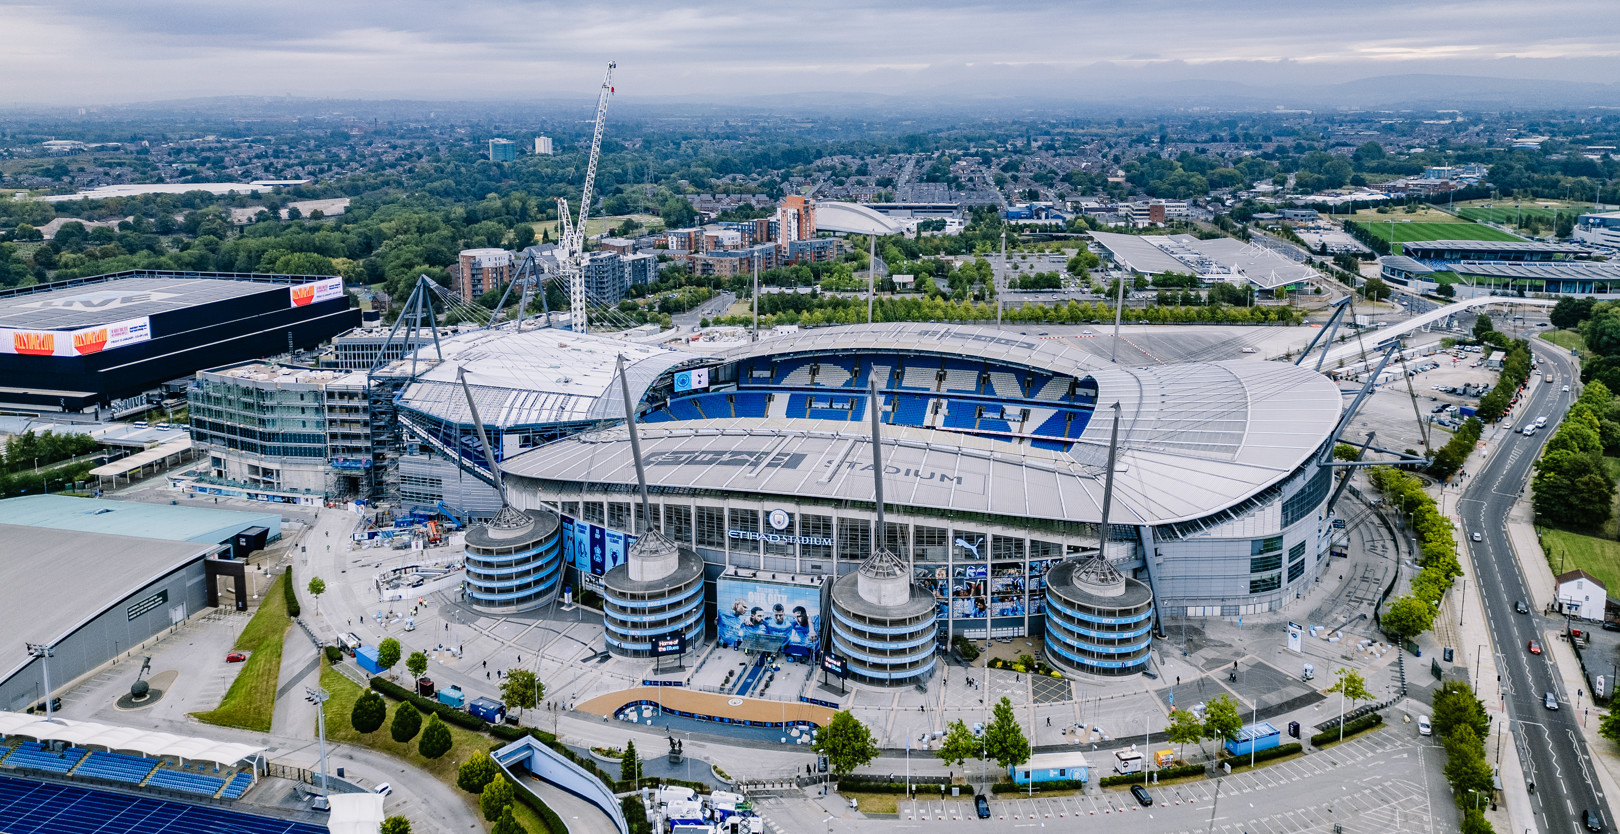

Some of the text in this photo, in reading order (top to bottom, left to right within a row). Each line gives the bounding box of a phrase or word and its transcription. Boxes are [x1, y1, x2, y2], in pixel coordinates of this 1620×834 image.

[650, 453, 963, 485] ETIHAD STADIUM
[728, 530, 833, 546] ETIHAD STADIUM
